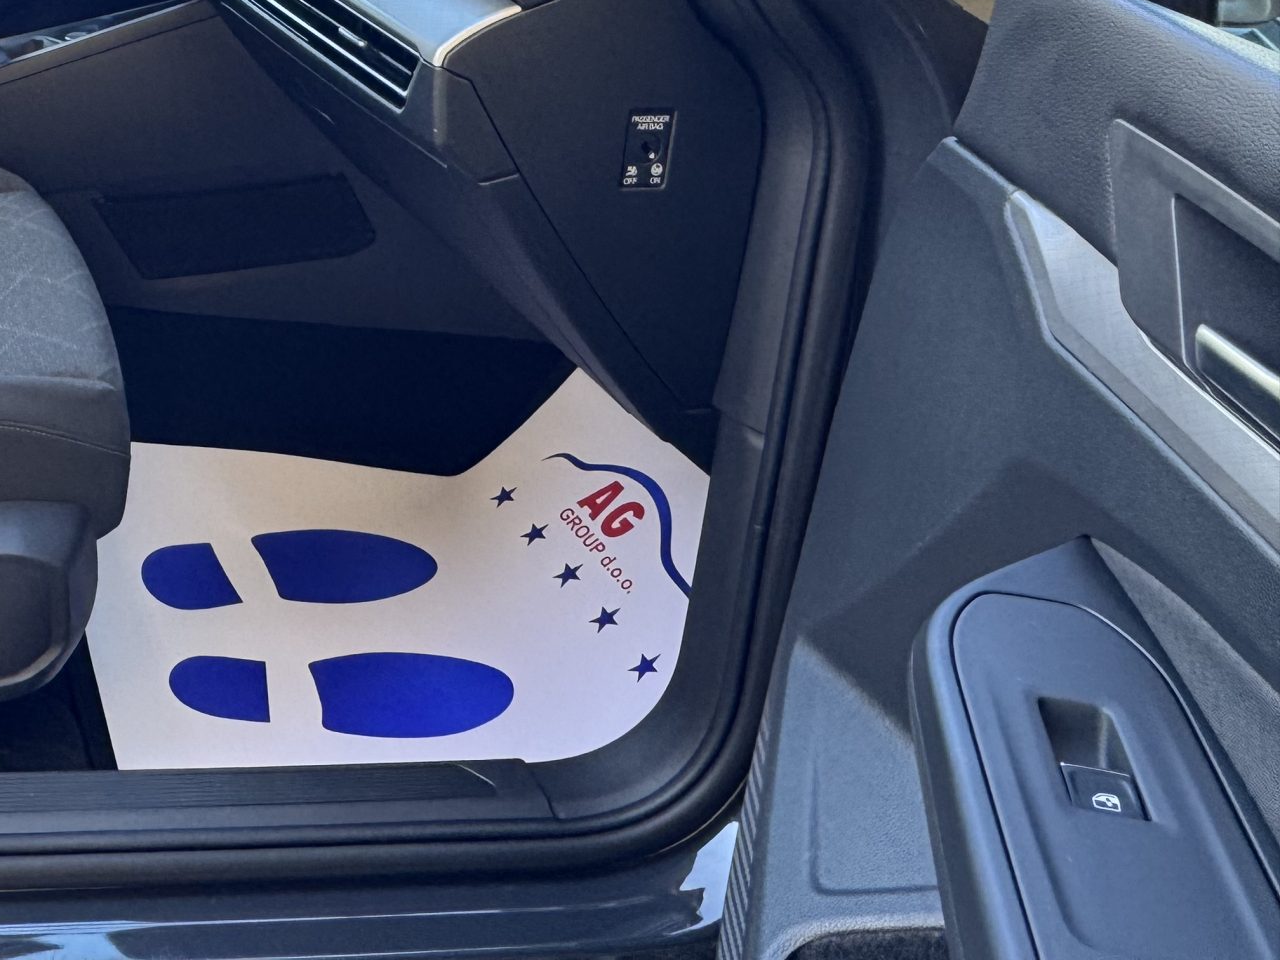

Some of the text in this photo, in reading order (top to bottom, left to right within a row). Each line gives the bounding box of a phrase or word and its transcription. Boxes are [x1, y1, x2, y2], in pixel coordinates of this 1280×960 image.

[623, 177, 638, 185] OFF
[576, 480, 646, 538] AG
[559, 508, 633, 594] GROUP d.o.o.
